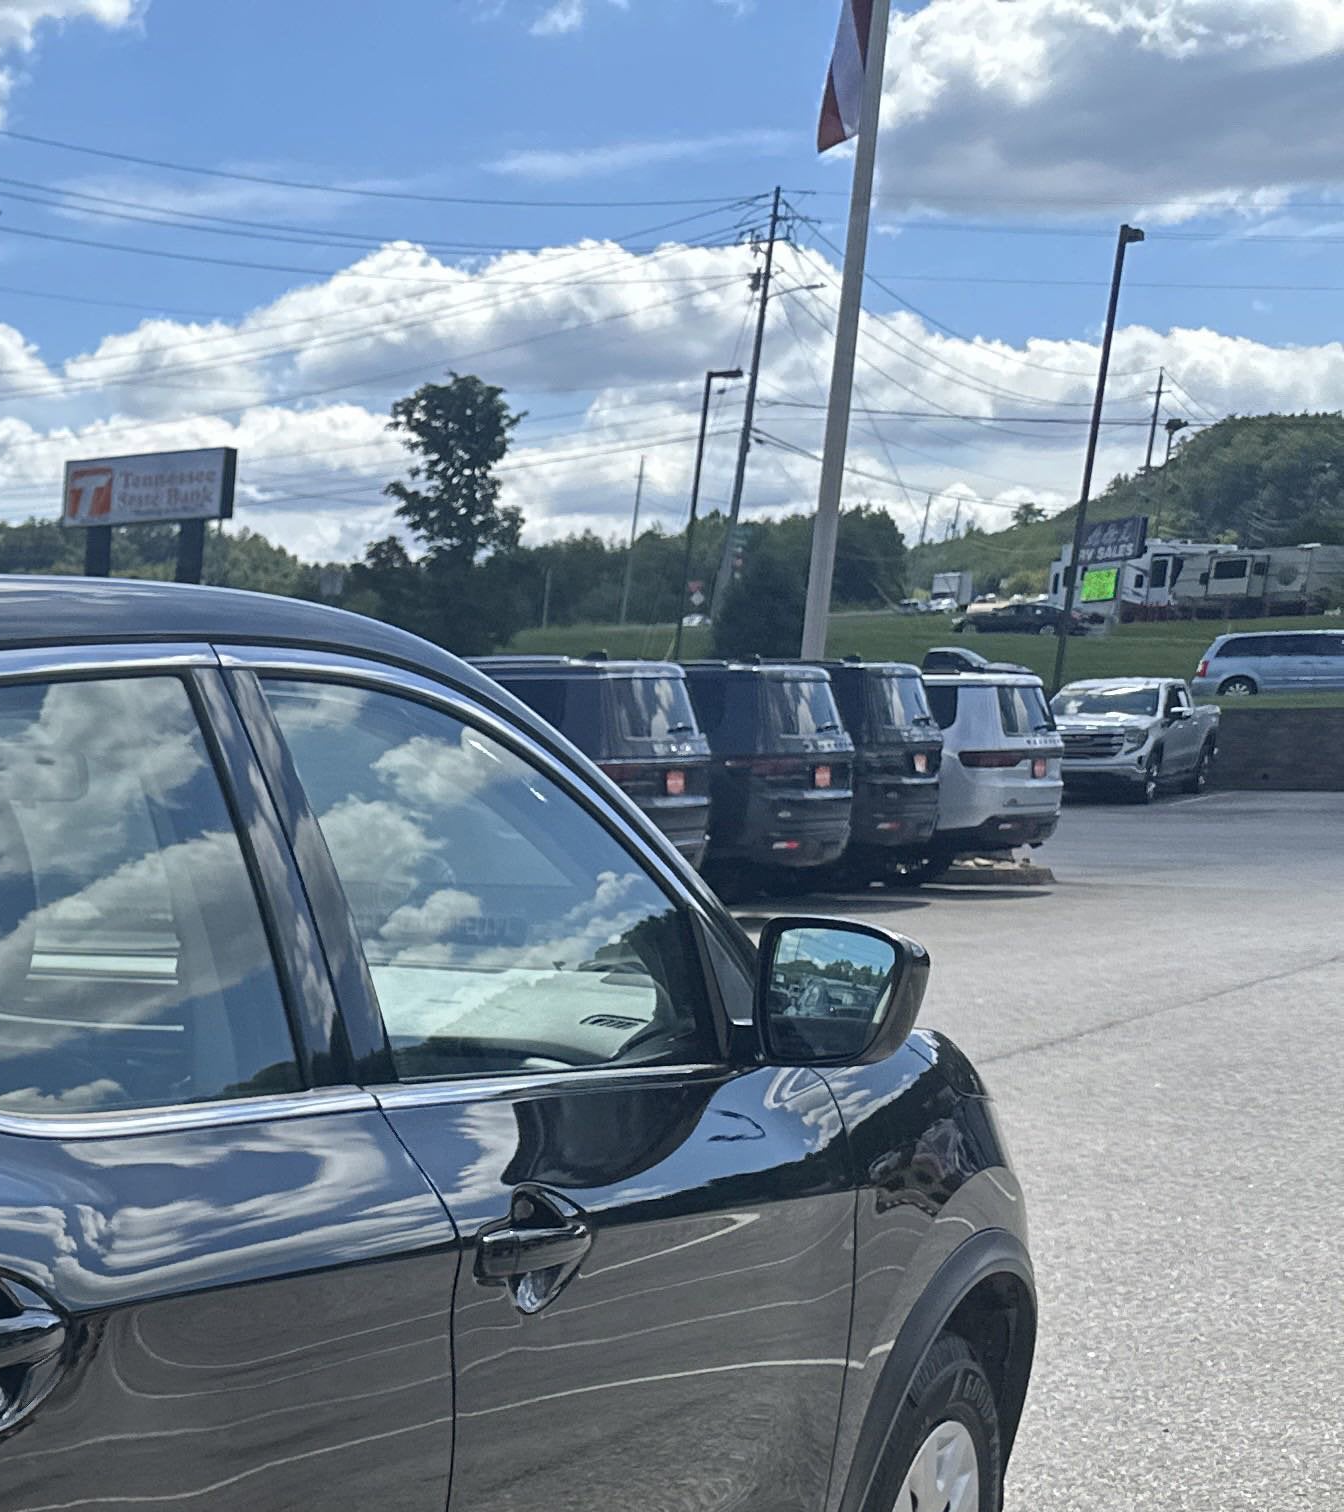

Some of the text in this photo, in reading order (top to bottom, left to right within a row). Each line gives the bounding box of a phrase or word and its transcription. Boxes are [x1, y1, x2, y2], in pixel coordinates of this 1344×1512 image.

[120, 468, 216, 489] Tennessee
[167, 486, 213, 507] Bank
[1095, 543, 1134, 561] SALES
